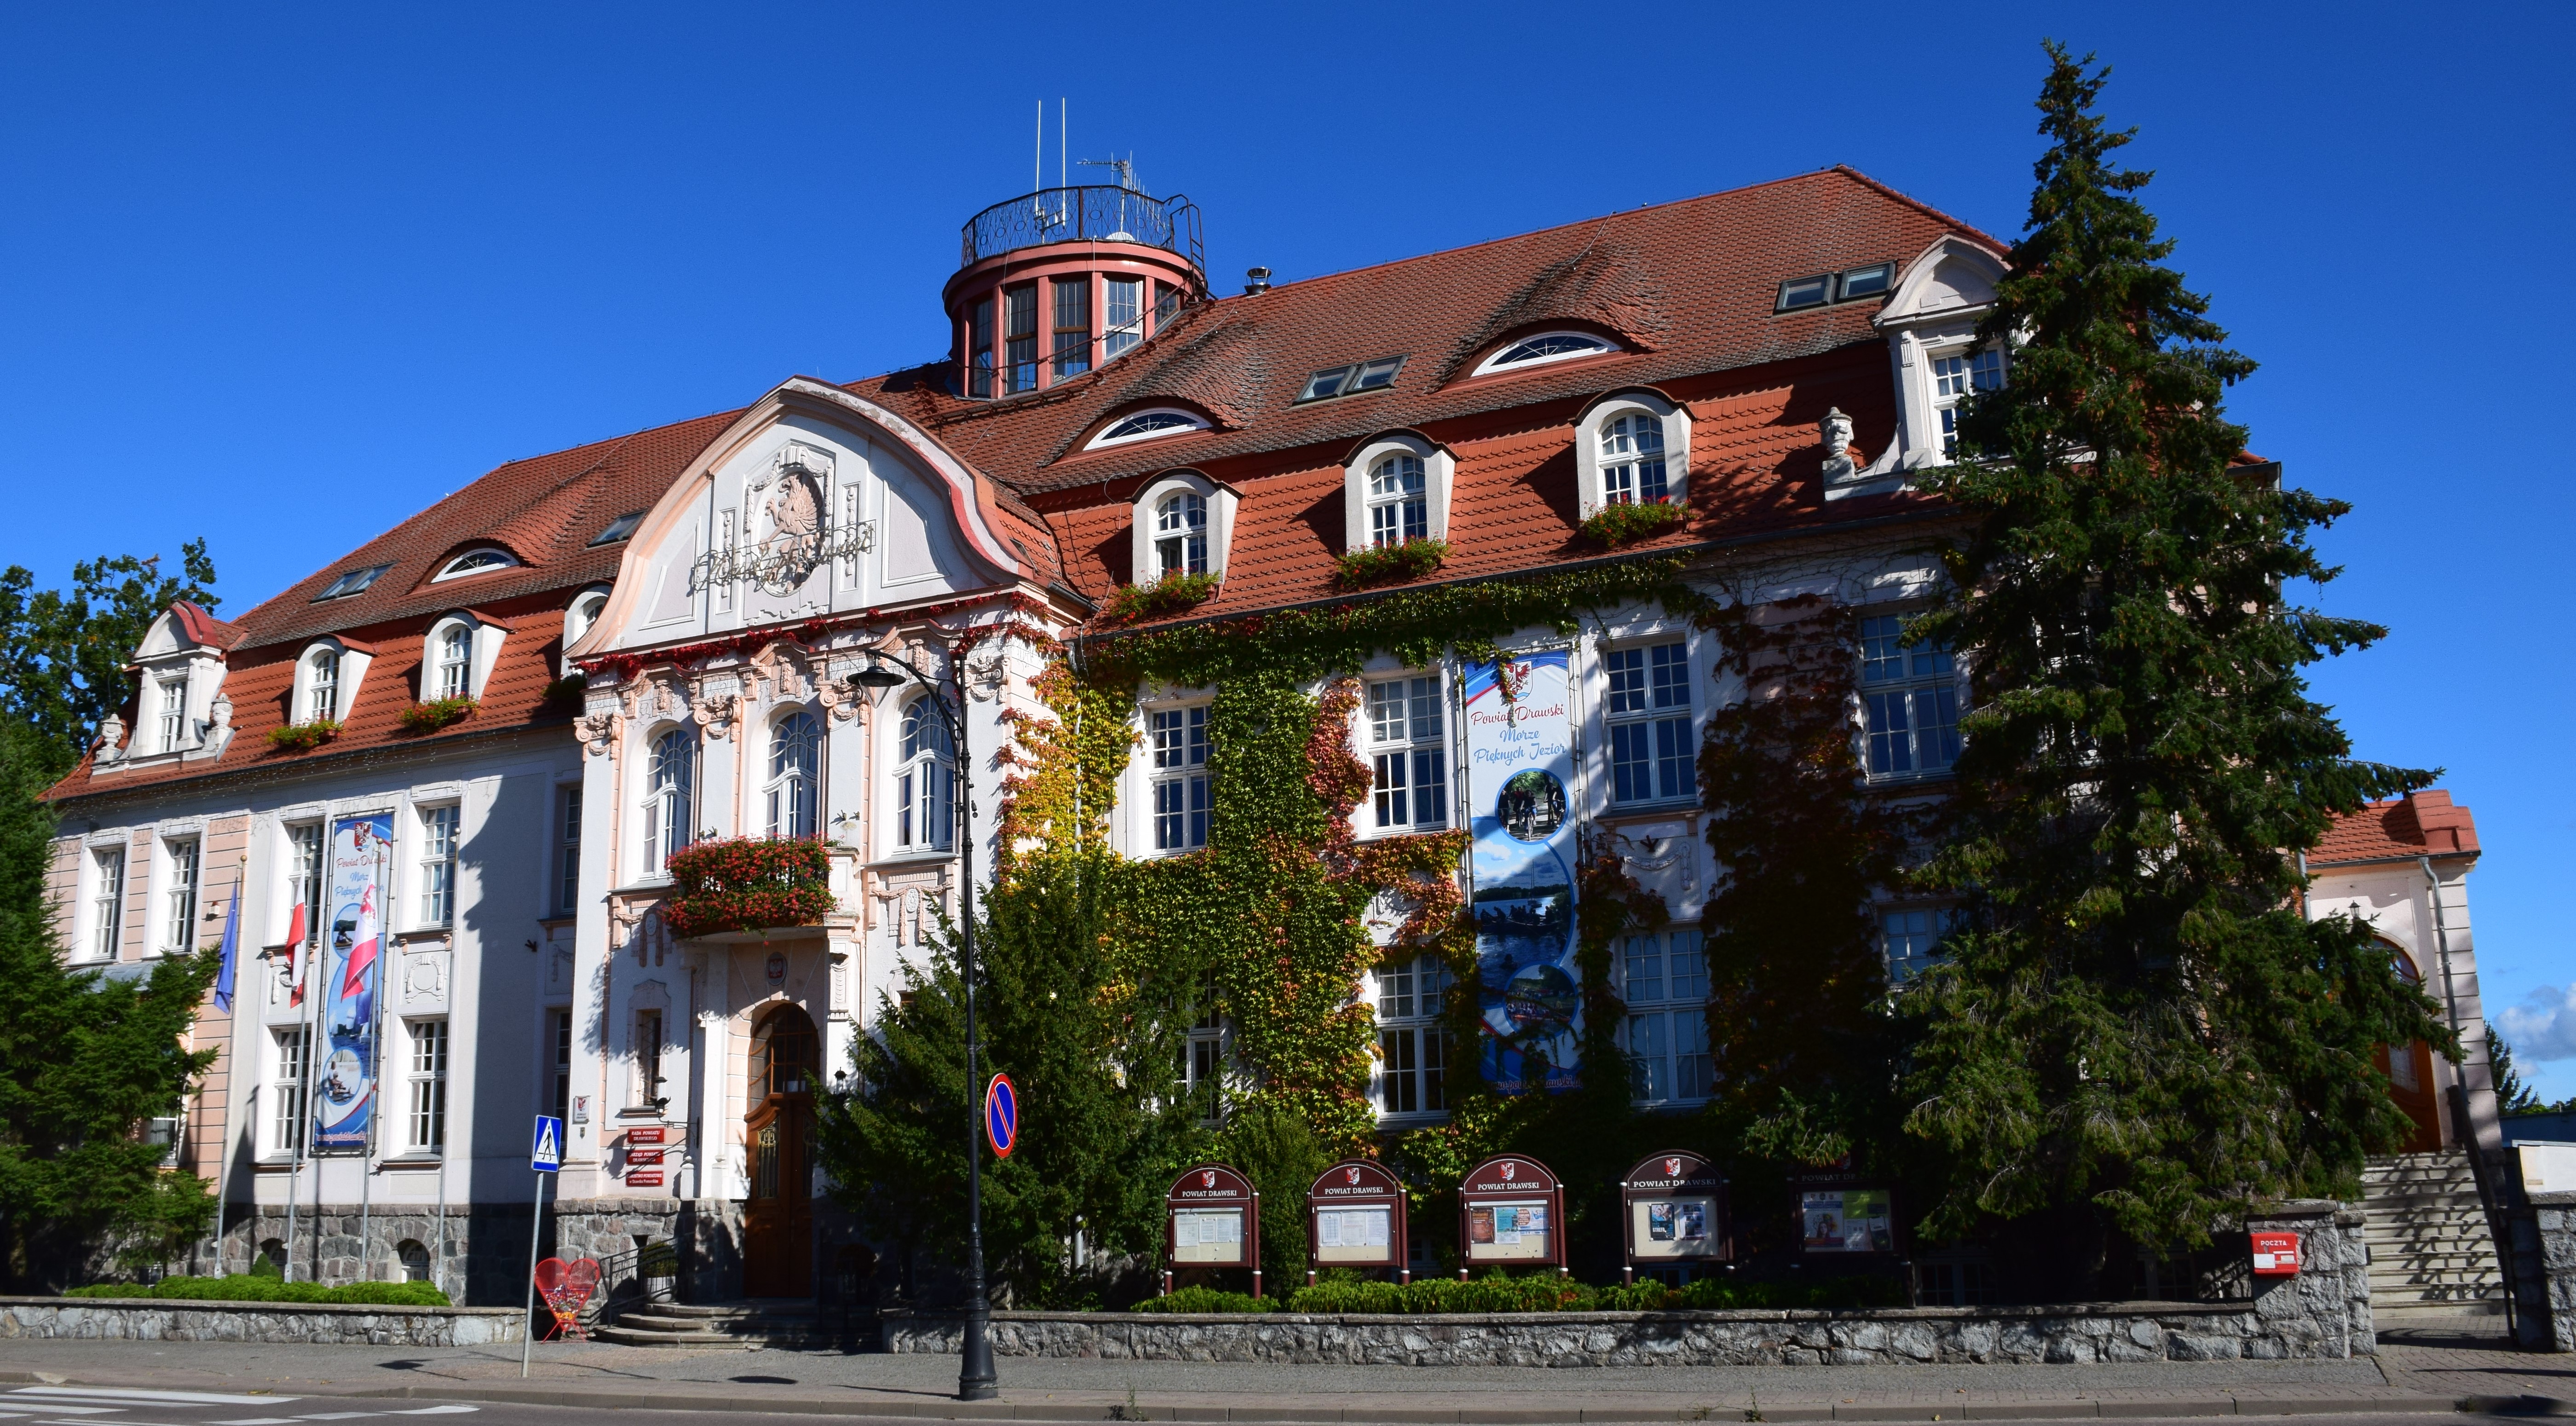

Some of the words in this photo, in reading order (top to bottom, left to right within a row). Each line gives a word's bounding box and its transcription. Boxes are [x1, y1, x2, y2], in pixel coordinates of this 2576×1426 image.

[1471, 711, 1511, 726] Powiat
[1515, 704, 1565, 721] Drawski
[1500, 728, 1540, 742] Morze
[1474, 746, 1525, 766] Pięknych
[1530, 743, 1566, 760] Jezior
[336, 858, 358, 868] Powiat
[350, 872, 369, 882] Morz
